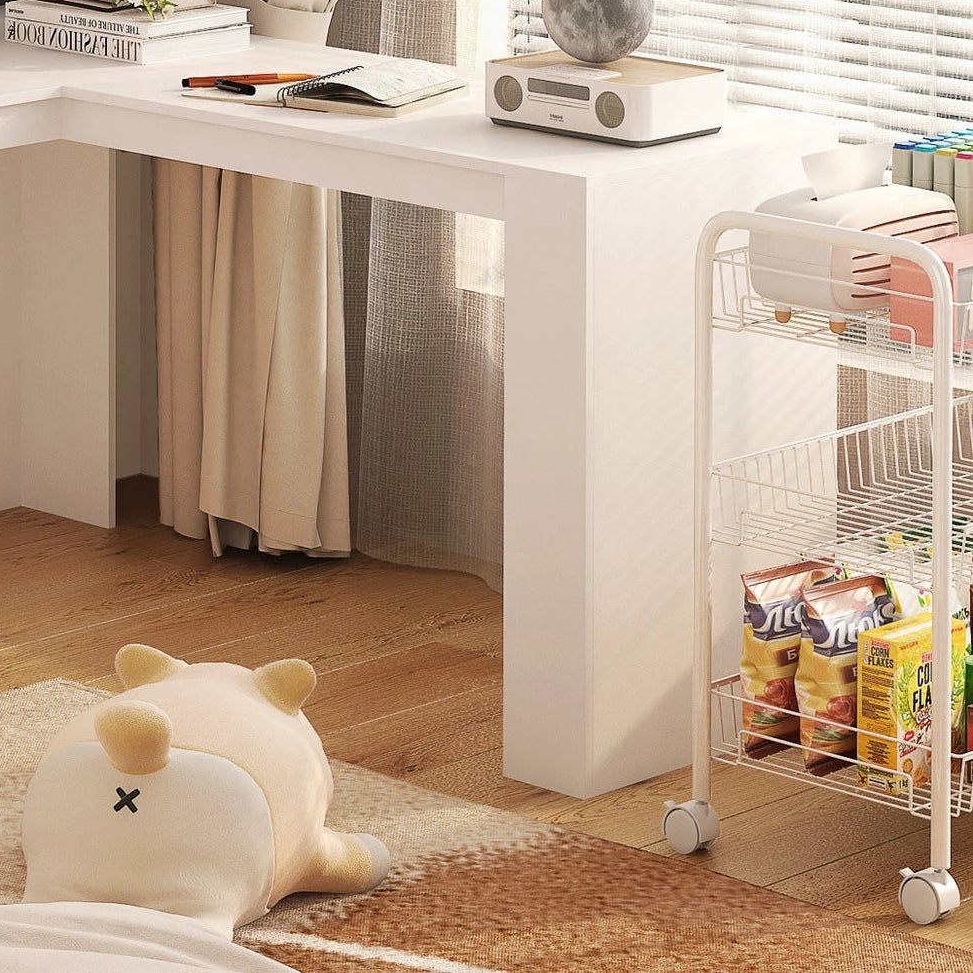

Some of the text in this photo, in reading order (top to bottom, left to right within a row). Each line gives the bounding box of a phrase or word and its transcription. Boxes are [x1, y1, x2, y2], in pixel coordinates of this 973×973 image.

[59, 14, 140, 35] THE ALLURE OF BEAUTY
[871, 646, 890, 658] CORN
[867, 656, 894, 669] FLAKES
